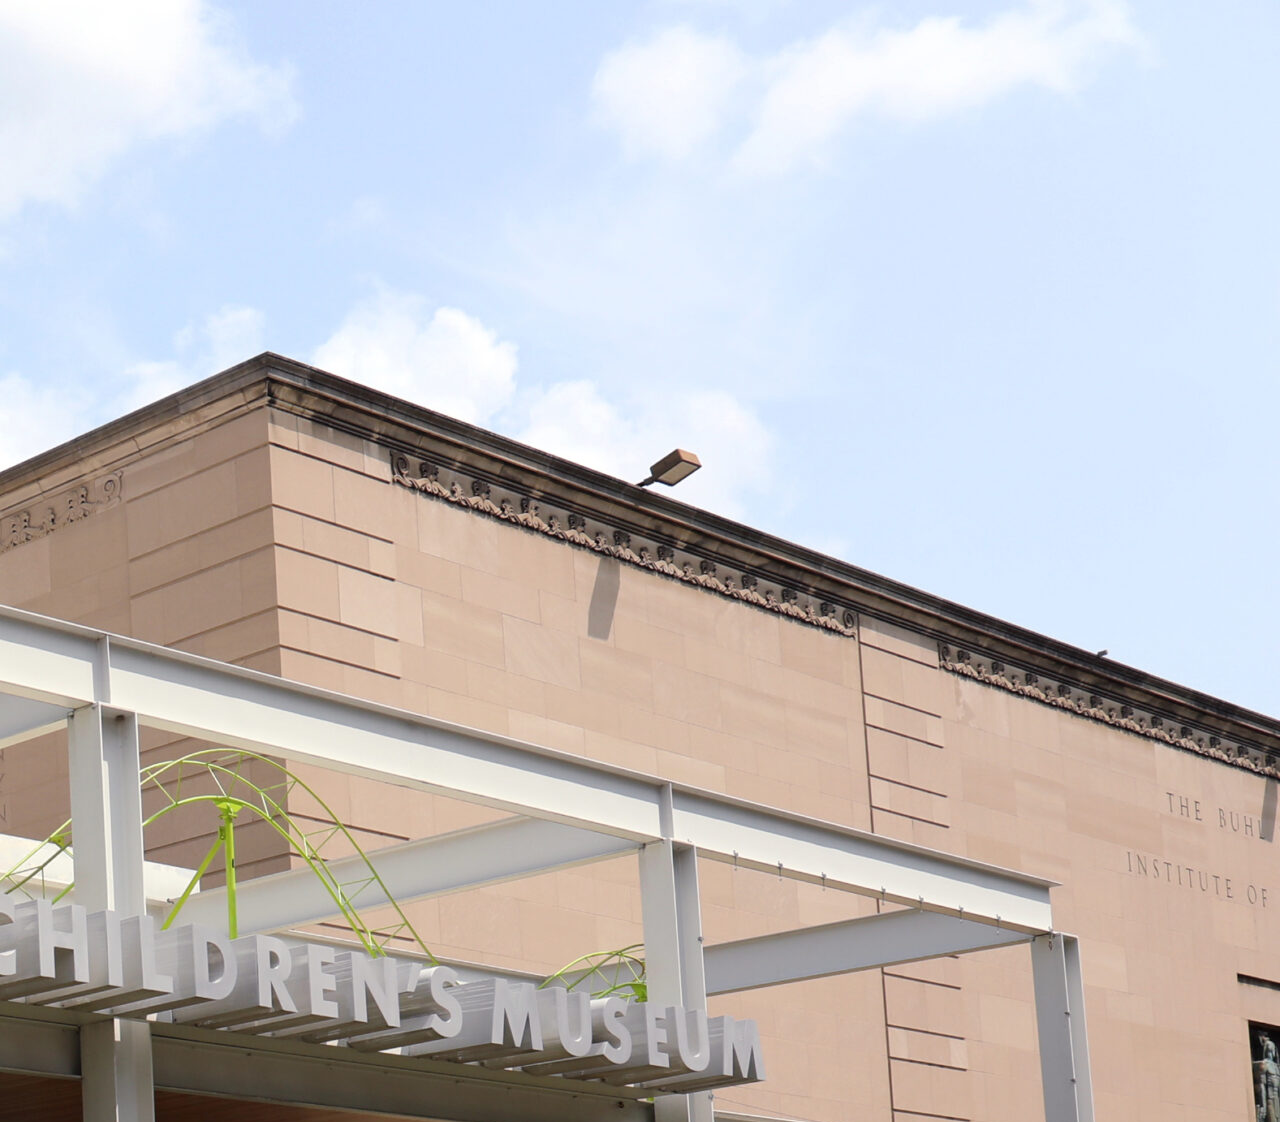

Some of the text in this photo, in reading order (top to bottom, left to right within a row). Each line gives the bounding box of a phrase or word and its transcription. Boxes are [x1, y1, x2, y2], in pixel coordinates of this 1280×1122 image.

[1166, 792, 1266, 840] THE BUHL
[1127, 851, 1269, 908] INSTITUTE OF
[491, 977, 766, 1082] MUSEUM
